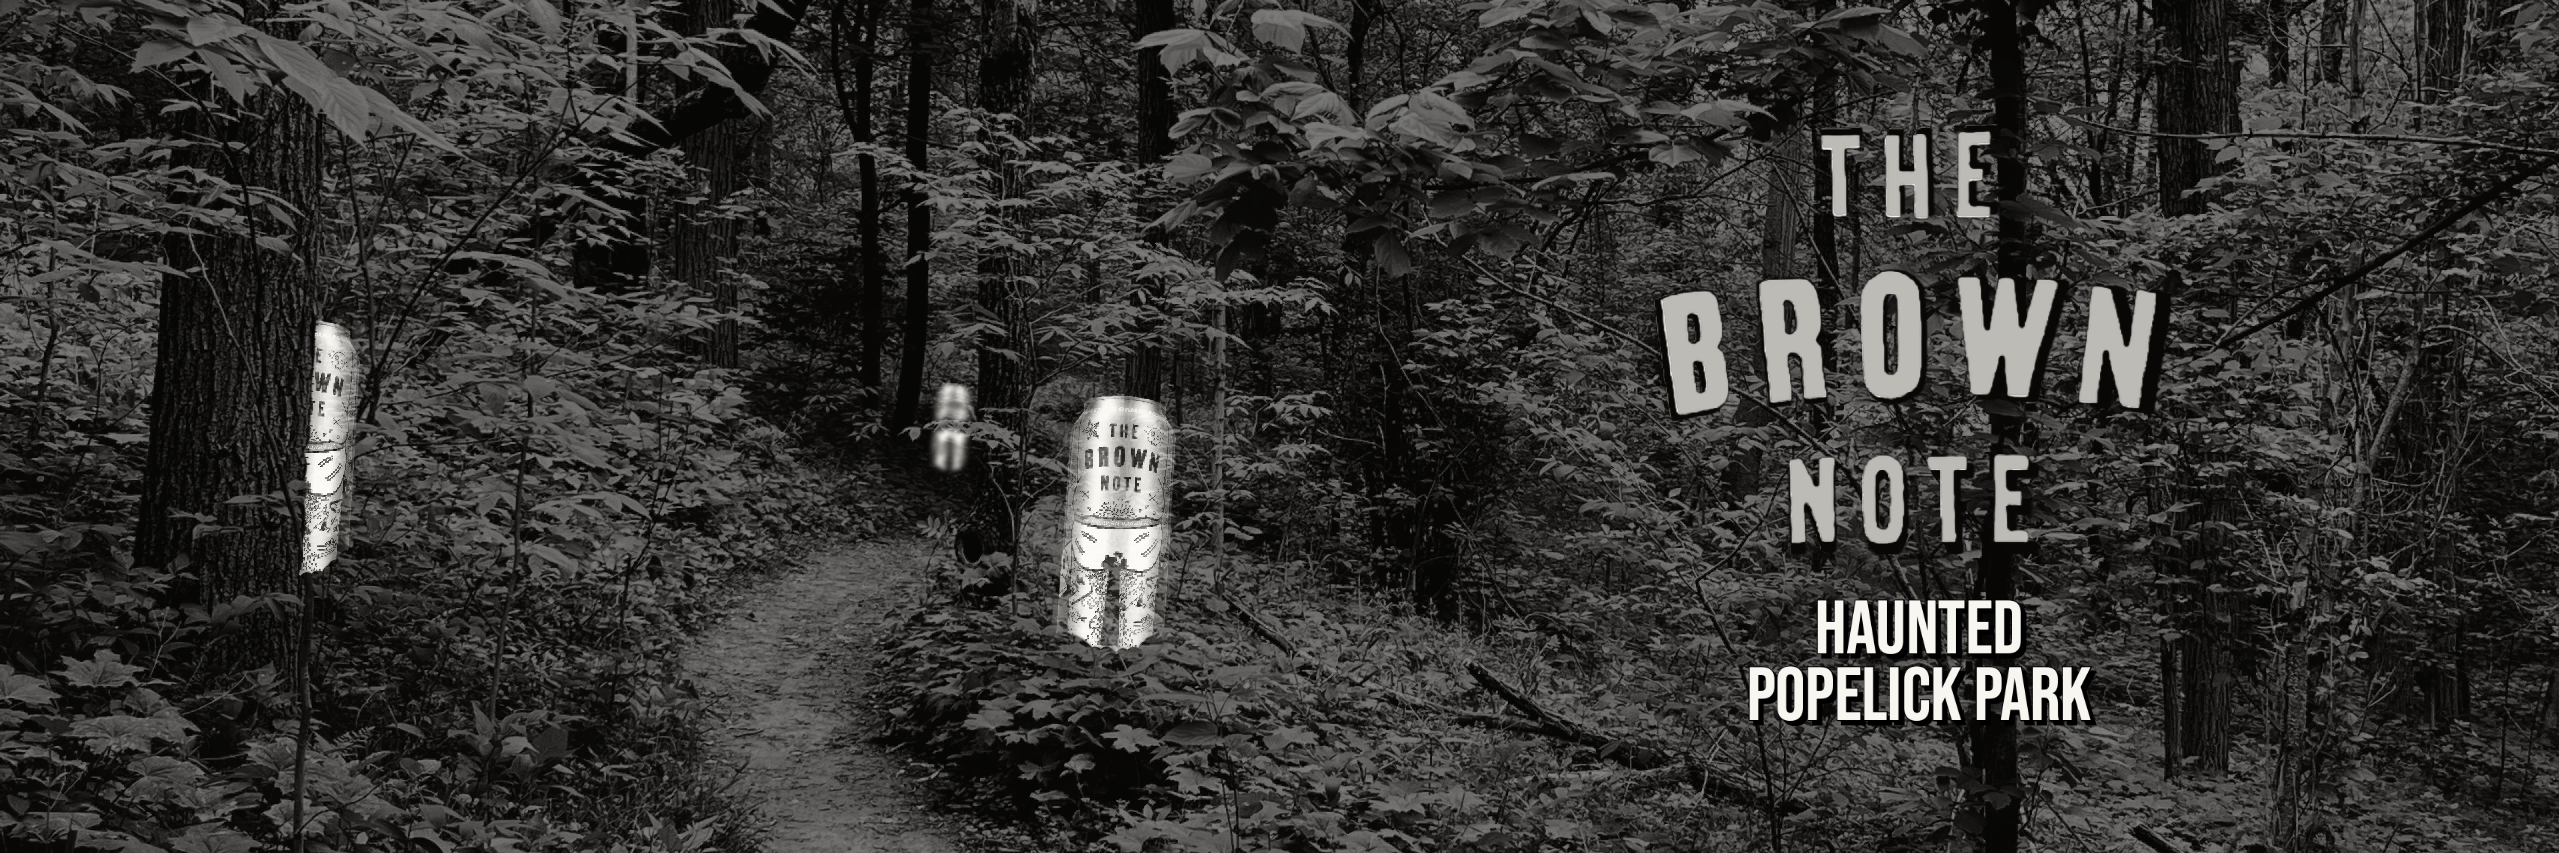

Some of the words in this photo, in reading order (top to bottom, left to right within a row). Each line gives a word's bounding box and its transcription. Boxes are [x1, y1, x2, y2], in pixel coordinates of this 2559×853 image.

[1109, 423, 1139, 440] THE
[1084, 446, 1160, 473] BROWN
[1100, 475, 1141, 493] NOTE
